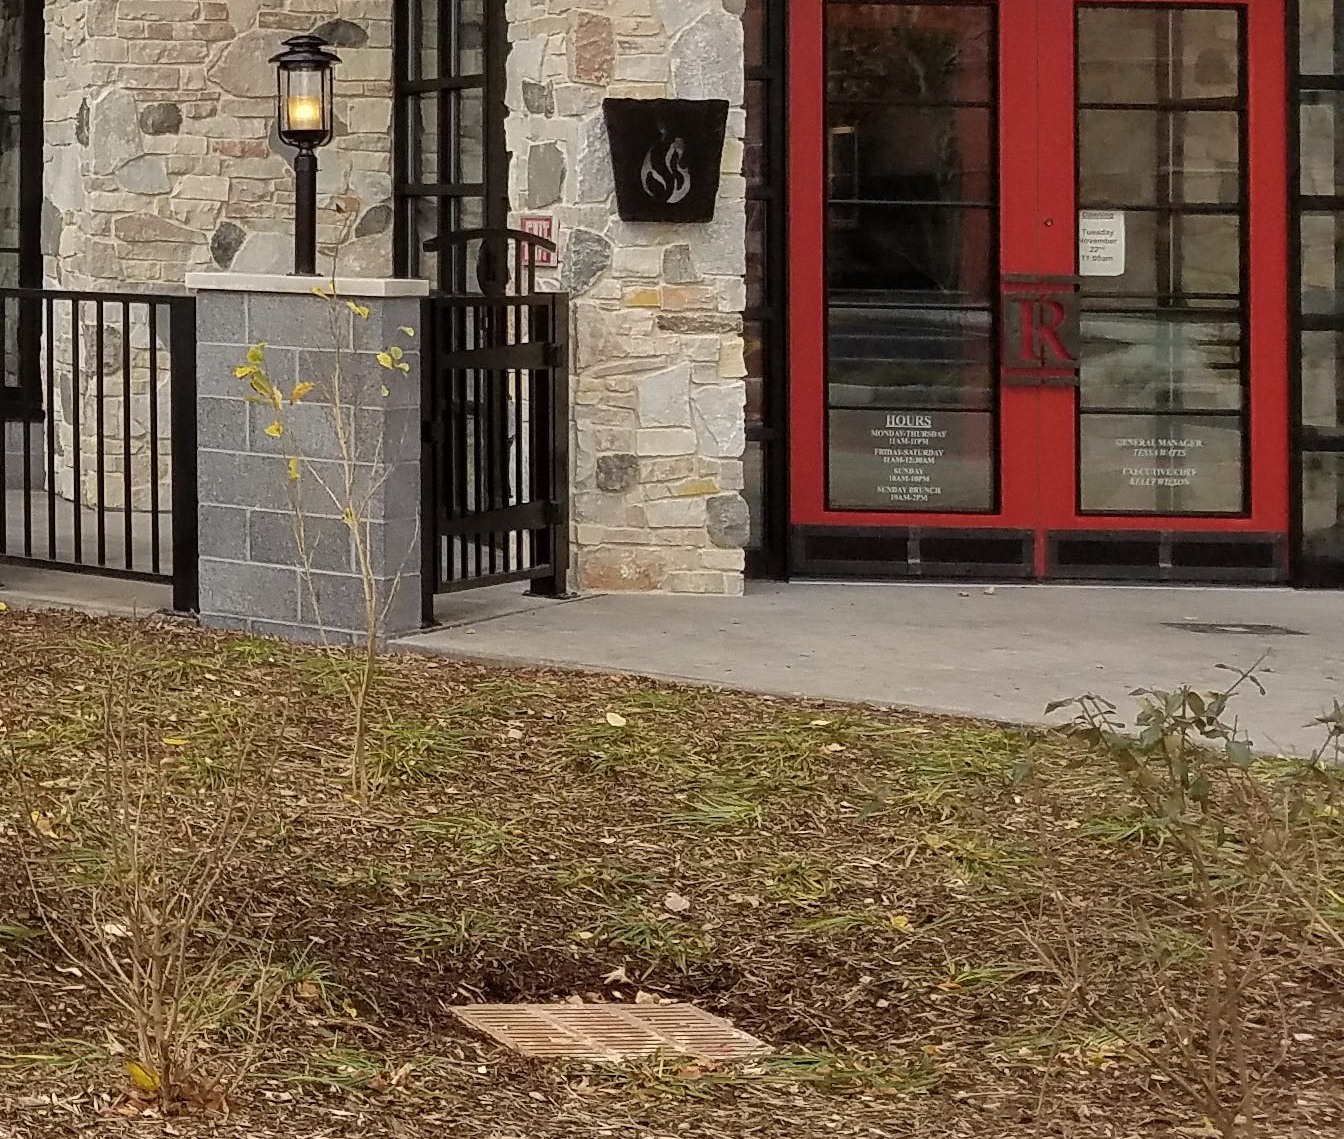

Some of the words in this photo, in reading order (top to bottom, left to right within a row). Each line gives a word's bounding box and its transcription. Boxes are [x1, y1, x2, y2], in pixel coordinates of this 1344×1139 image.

[1082, 228, 1115, 237] Tuesday
[1016, 299, 1075, 361] R
[886, 414, 932, 428] HOURS
[1115, 438, 1156, 447] GENERAL
[1158, 439, 1203, 447] MANAGER
[893, 467, 924, 475] SUNDAY
[876, 486, 907, 494] SUNDAY
[909, 486, 941, 494] BRUNCH
